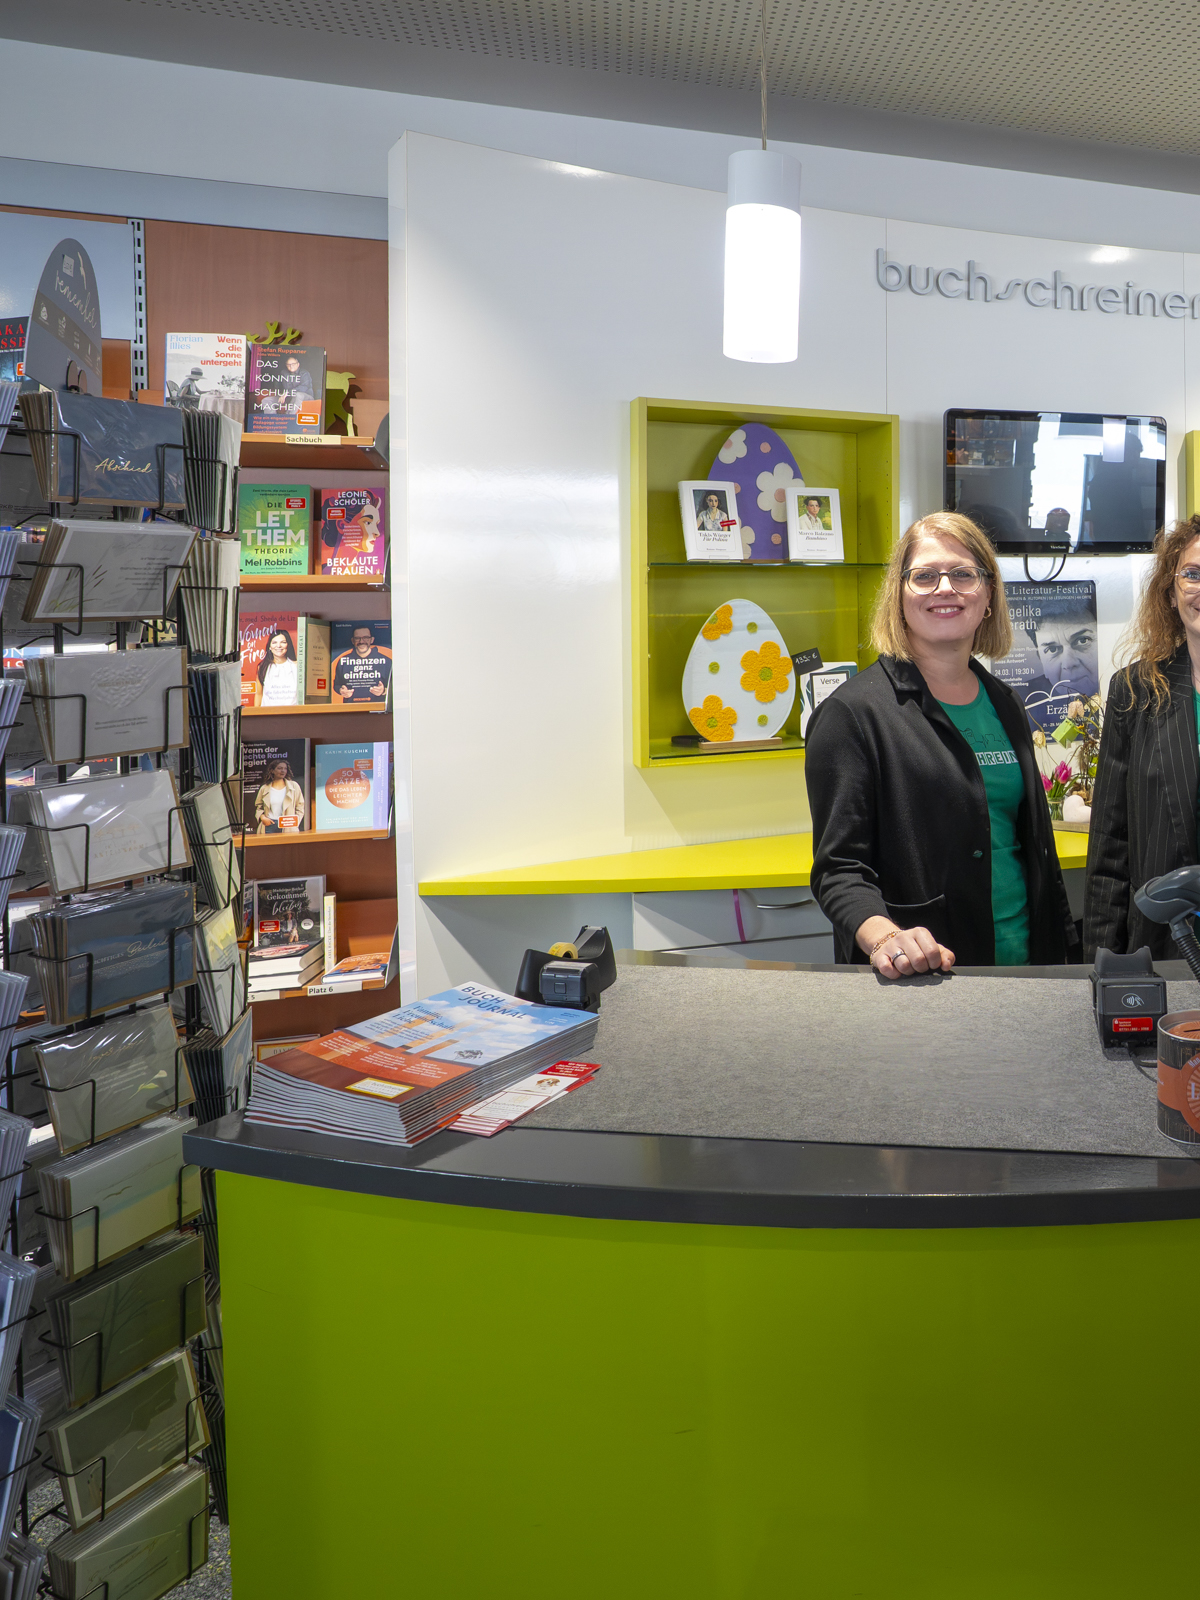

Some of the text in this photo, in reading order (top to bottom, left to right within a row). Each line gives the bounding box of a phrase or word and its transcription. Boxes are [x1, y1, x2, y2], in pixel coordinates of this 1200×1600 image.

[170, 334, 203, 342] Florian
[217, 336, 242, 344] Wenn
[170, 342, 190, 350] Illies
[256, 360, 278, 368] DAS
[255, 373, 300, 382] KÖNNTE
[254, 388, 297, 396] SCHULE
[254, 402, 302, 411] MACHEN
[286, 436, 322, 444] Sachbuch
[338, 490, 368, 498] LEONIE
[334, 498, 371, 506] SCHÖLER
[256, 510, 294, 528] LET
[242, 530, 305, 546] THEM
[264, 558, 302, 566] Robbins
[327, 556, 378, 567] BEKLAUTE
[331, 566, 374, 576] FRAUEN
[1012, 584, 1092, 596] Literatur-Festival
[1008, 606, 1042, 618] gelika
[240, 648, 267, 668] Fire
[340, 657, 386, 665] Finanzen
[354, 665, 373, 673] ganz
[344, 671, 381, 679] einfach
[820, 677, 840, 685] Verse
[333, 777, 360, 785] SÄTZE
[461, 986, 506, 1004] BUCH
[458, 996, 528, 1019] JOURNAL
